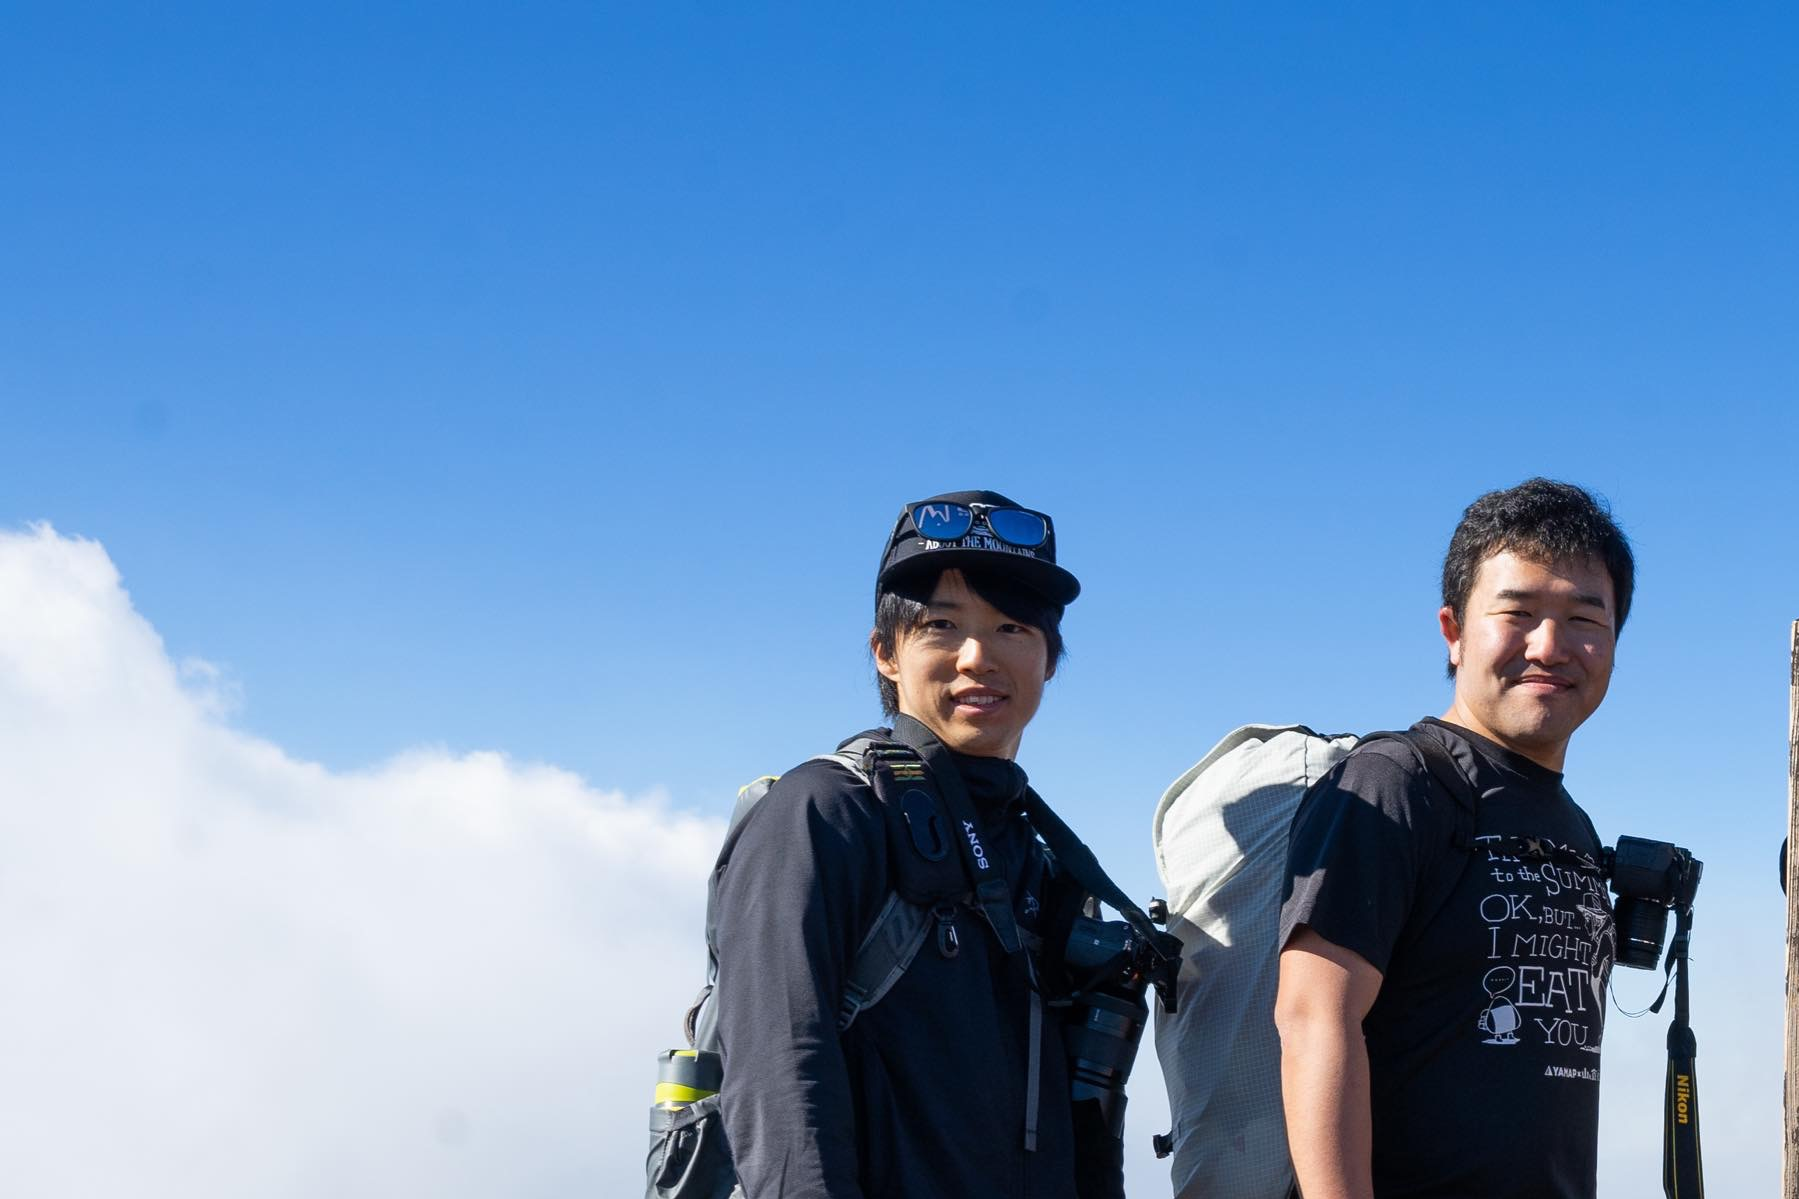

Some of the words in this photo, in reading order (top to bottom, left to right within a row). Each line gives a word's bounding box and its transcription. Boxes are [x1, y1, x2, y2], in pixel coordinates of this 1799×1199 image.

[962, 820, 990, 869] SONY
[1490, 868, 1514, 882] to
[1517, 866, 1541, 882] the
[1541, 861, 1608, 899] SUMM
[1487, 927, 1501, 959] I
[1511, 933, 1592, 966] MIGHT
[1515, 965, 1589, 1013] EAT
[1534, 1018, 1589, 1046] YOU
[1676, 1074, 1689, 1125] Nikon
